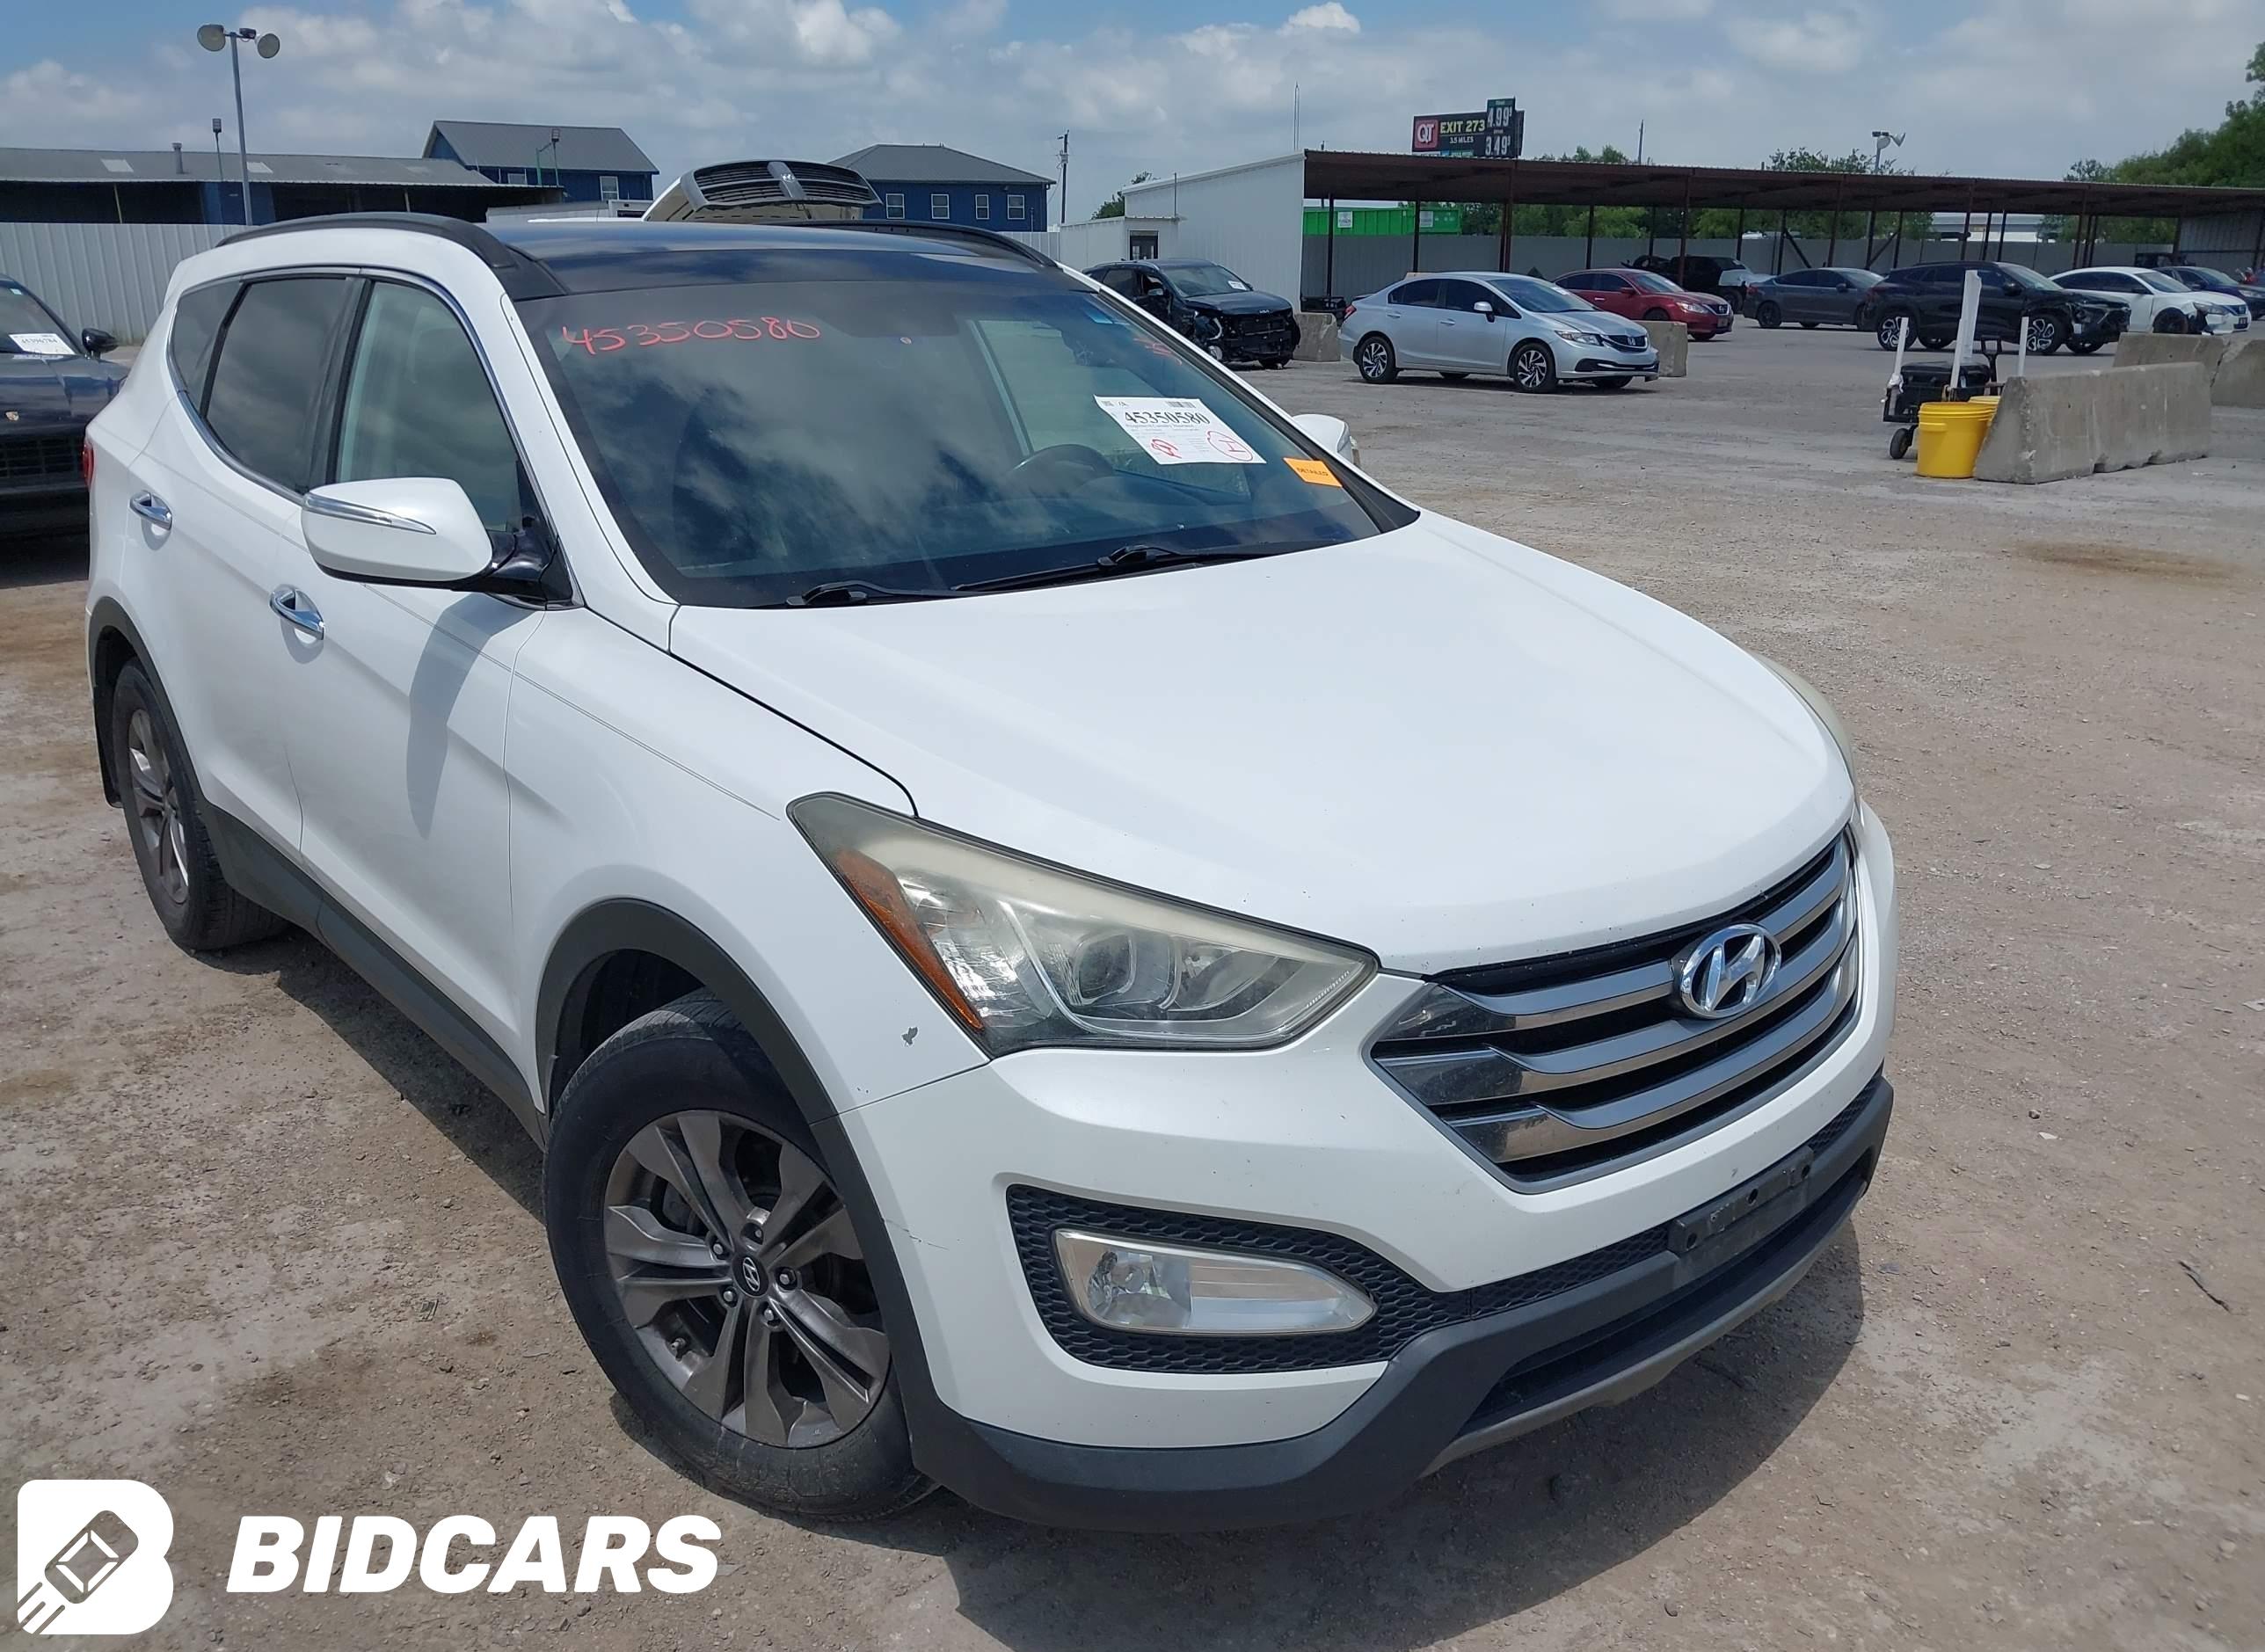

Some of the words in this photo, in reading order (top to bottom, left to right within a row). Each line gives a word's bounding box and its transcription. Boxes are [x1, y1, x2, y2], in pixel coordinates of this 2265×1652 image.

[1417, 123, 1435, 143] QT
[1439, 120, 1464, 135] EXIT
[1465, 119, 1486, 133] 273
[1459, 135, 1475, 144] MILES
[563, 316, 822, 356] 45350580
[1125, 411, 1211, 425] 45350580
